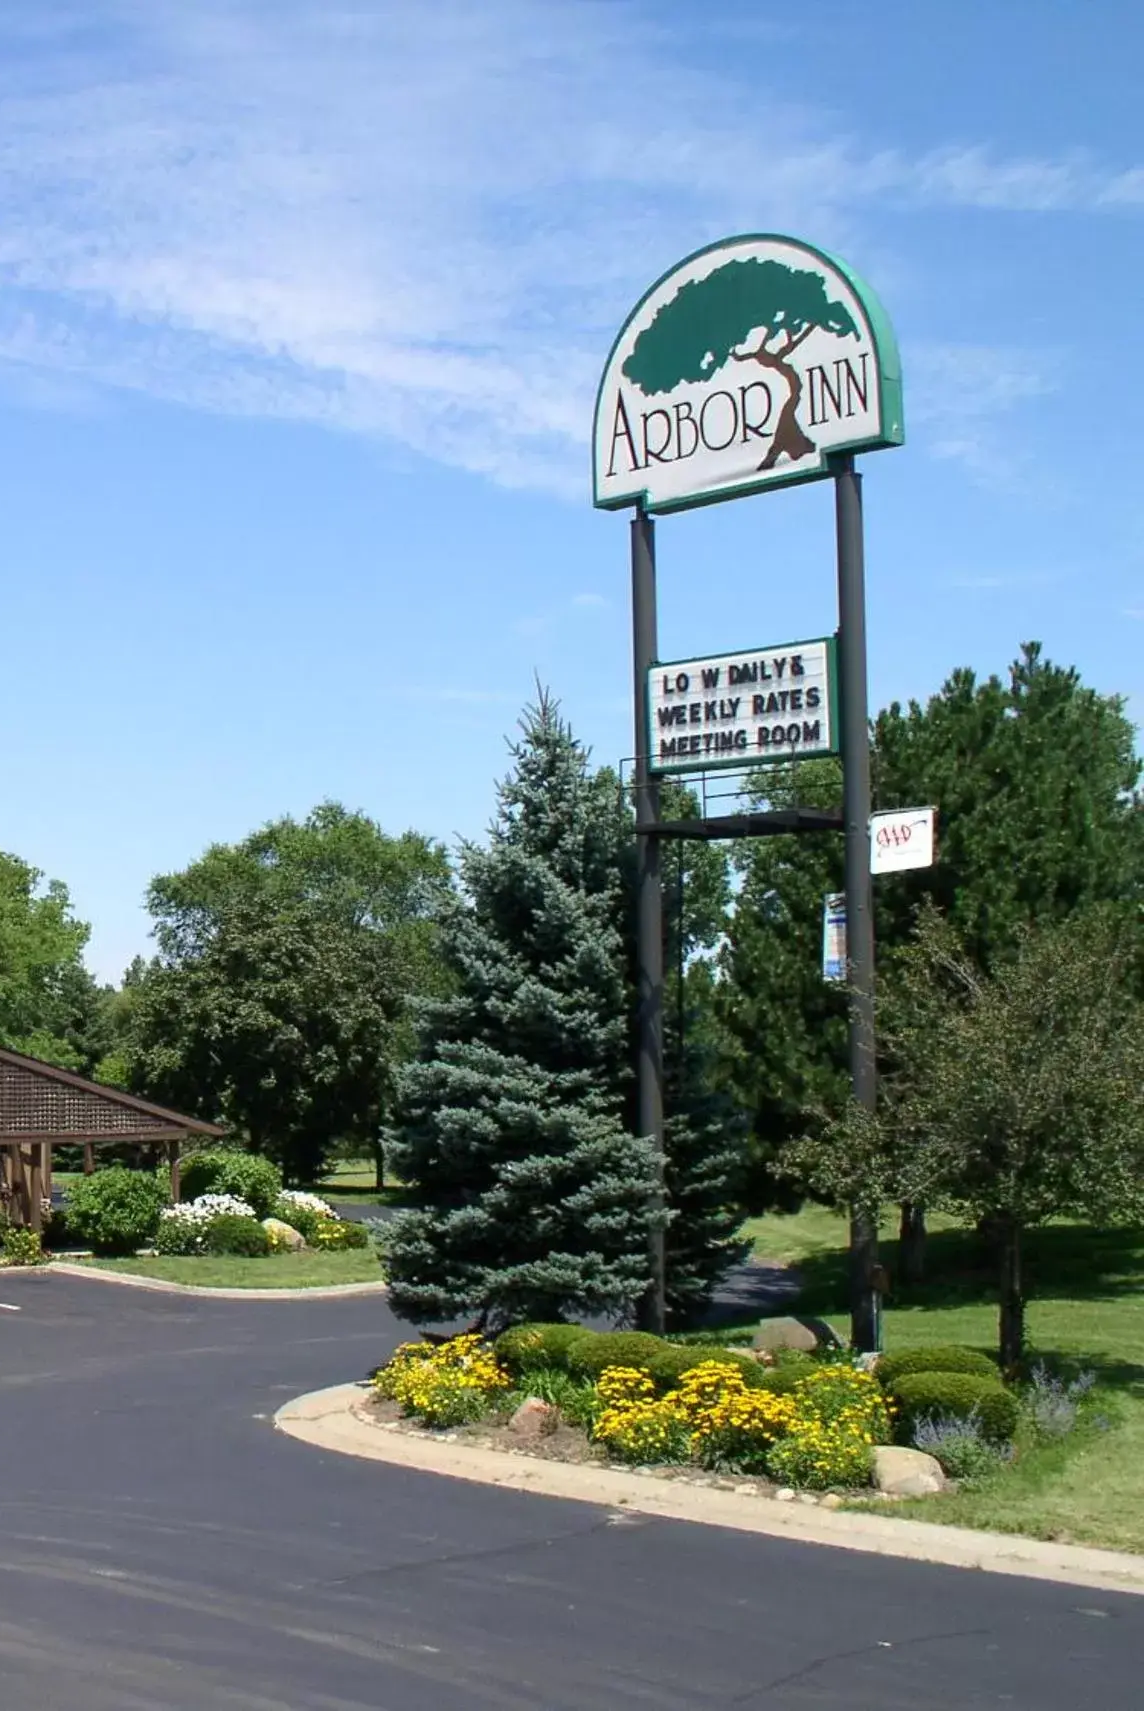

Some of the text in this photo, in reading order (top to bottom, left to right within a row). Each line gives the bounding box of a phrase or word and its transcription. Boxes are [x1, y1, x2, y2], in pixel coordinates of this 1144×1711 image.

[606, 353, 870, 477] ARBOR INN
[658, 687, 820, 726] WEEKLY RATES
[660, 720, 820, 757] MEETING ROOM
